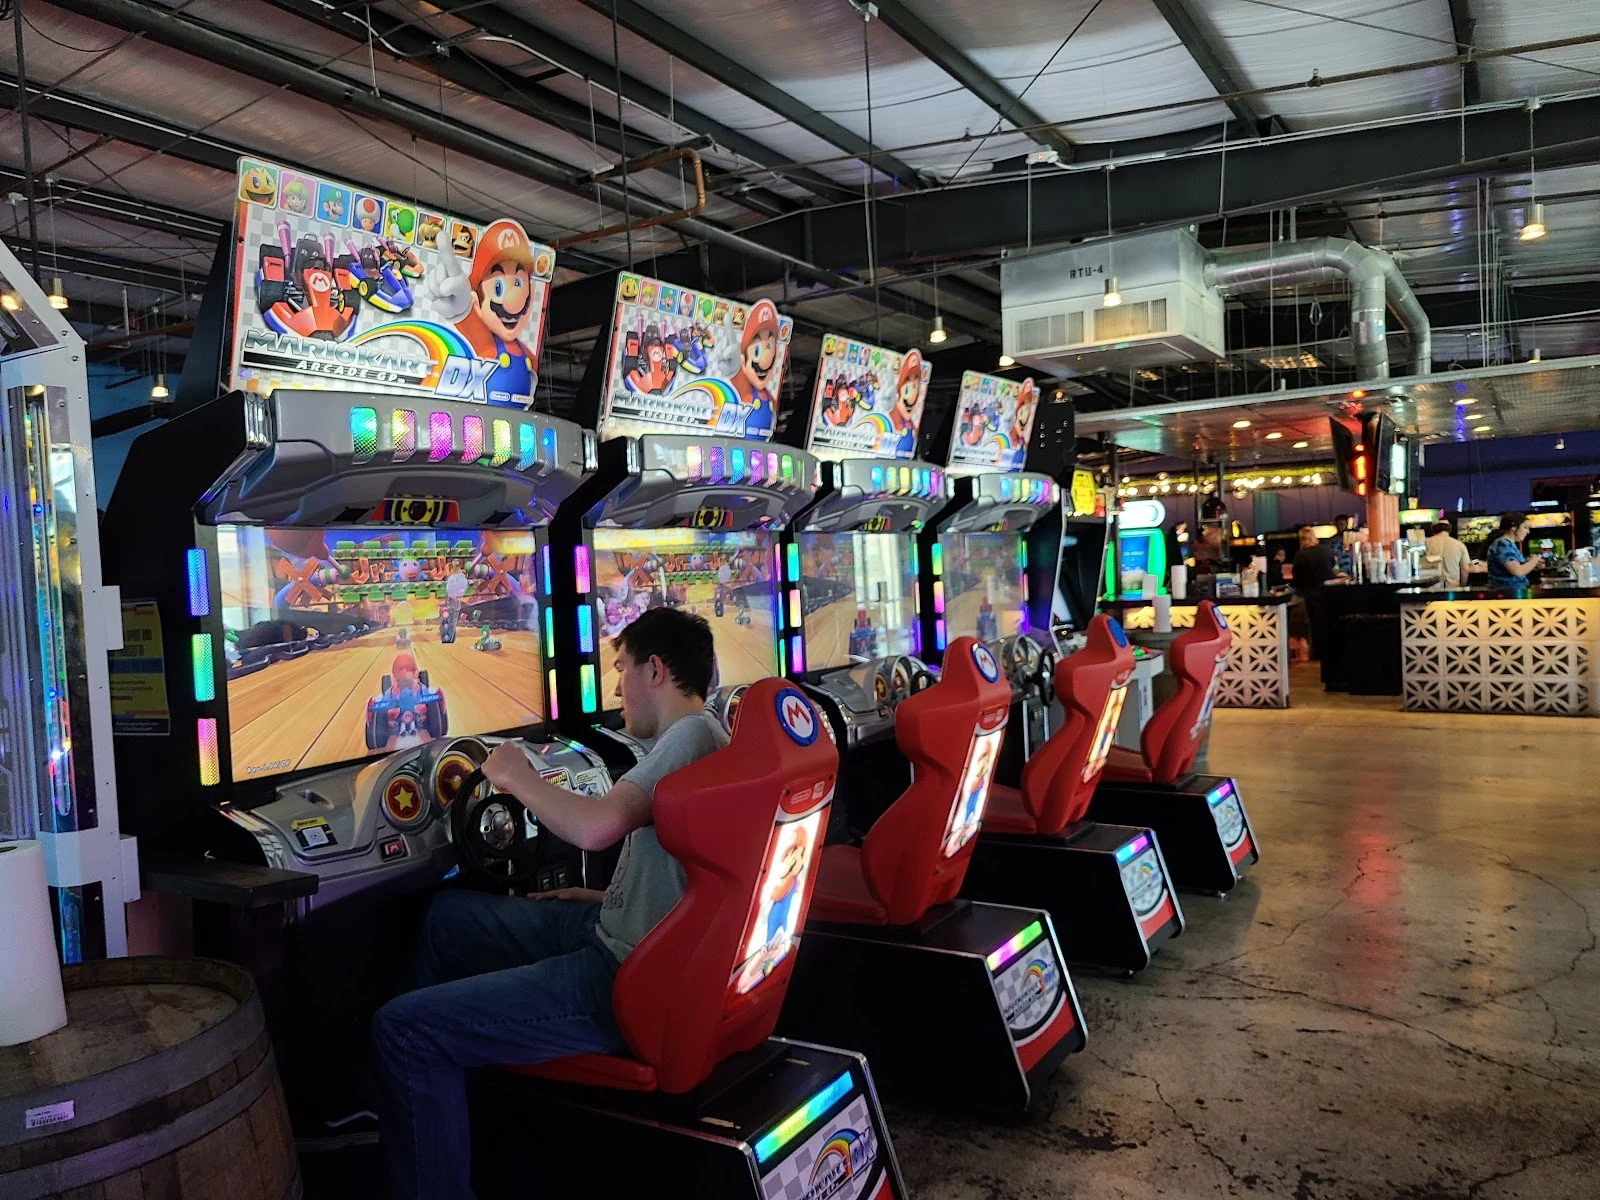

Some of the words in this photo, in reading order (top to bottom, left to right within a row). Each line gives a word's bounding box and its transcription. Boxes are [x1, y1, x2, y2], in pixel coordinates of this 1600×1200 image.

[1069, 264, 1103, 279] RTU-4
[296, 360, 369, 379] ARCADE
[434, 354, 500, 404] DX
[715, 401, 755, 437] DX
[787, 702, 811, 729] M
